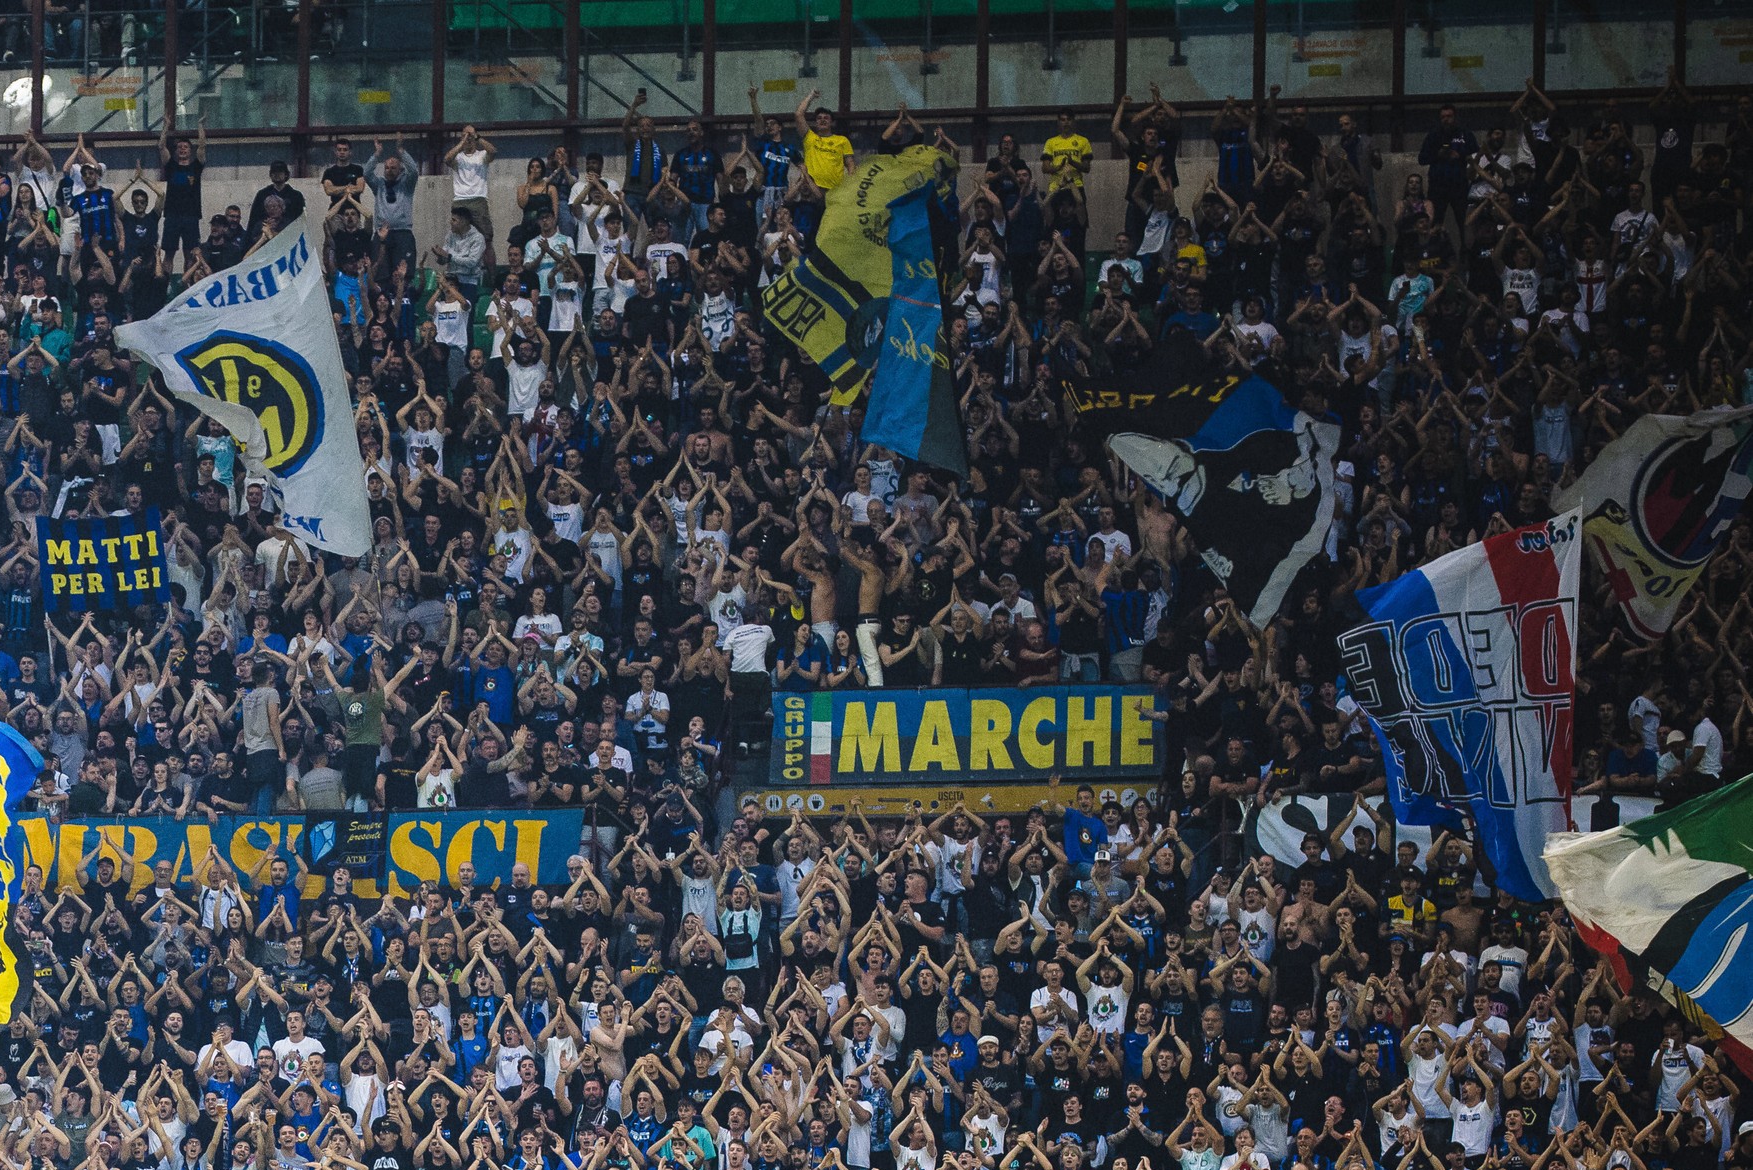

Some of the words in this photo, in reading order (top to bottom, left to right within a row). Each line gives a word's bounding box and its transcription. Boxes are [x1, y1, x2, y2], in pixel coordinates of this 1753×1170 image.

[46, 530, 158, 565] MATTI
[51, 571, 107, 595] PER
[117, 570, 162, 593] LEI
[783, 697, 805, 780] GRUPPO
[837, 695, 1155, 774] MARCHE
[937, 791, 965, 802] USCITA
[348, 820, 383, 833] Sempre
[346, 855, 367, 864] ATM
